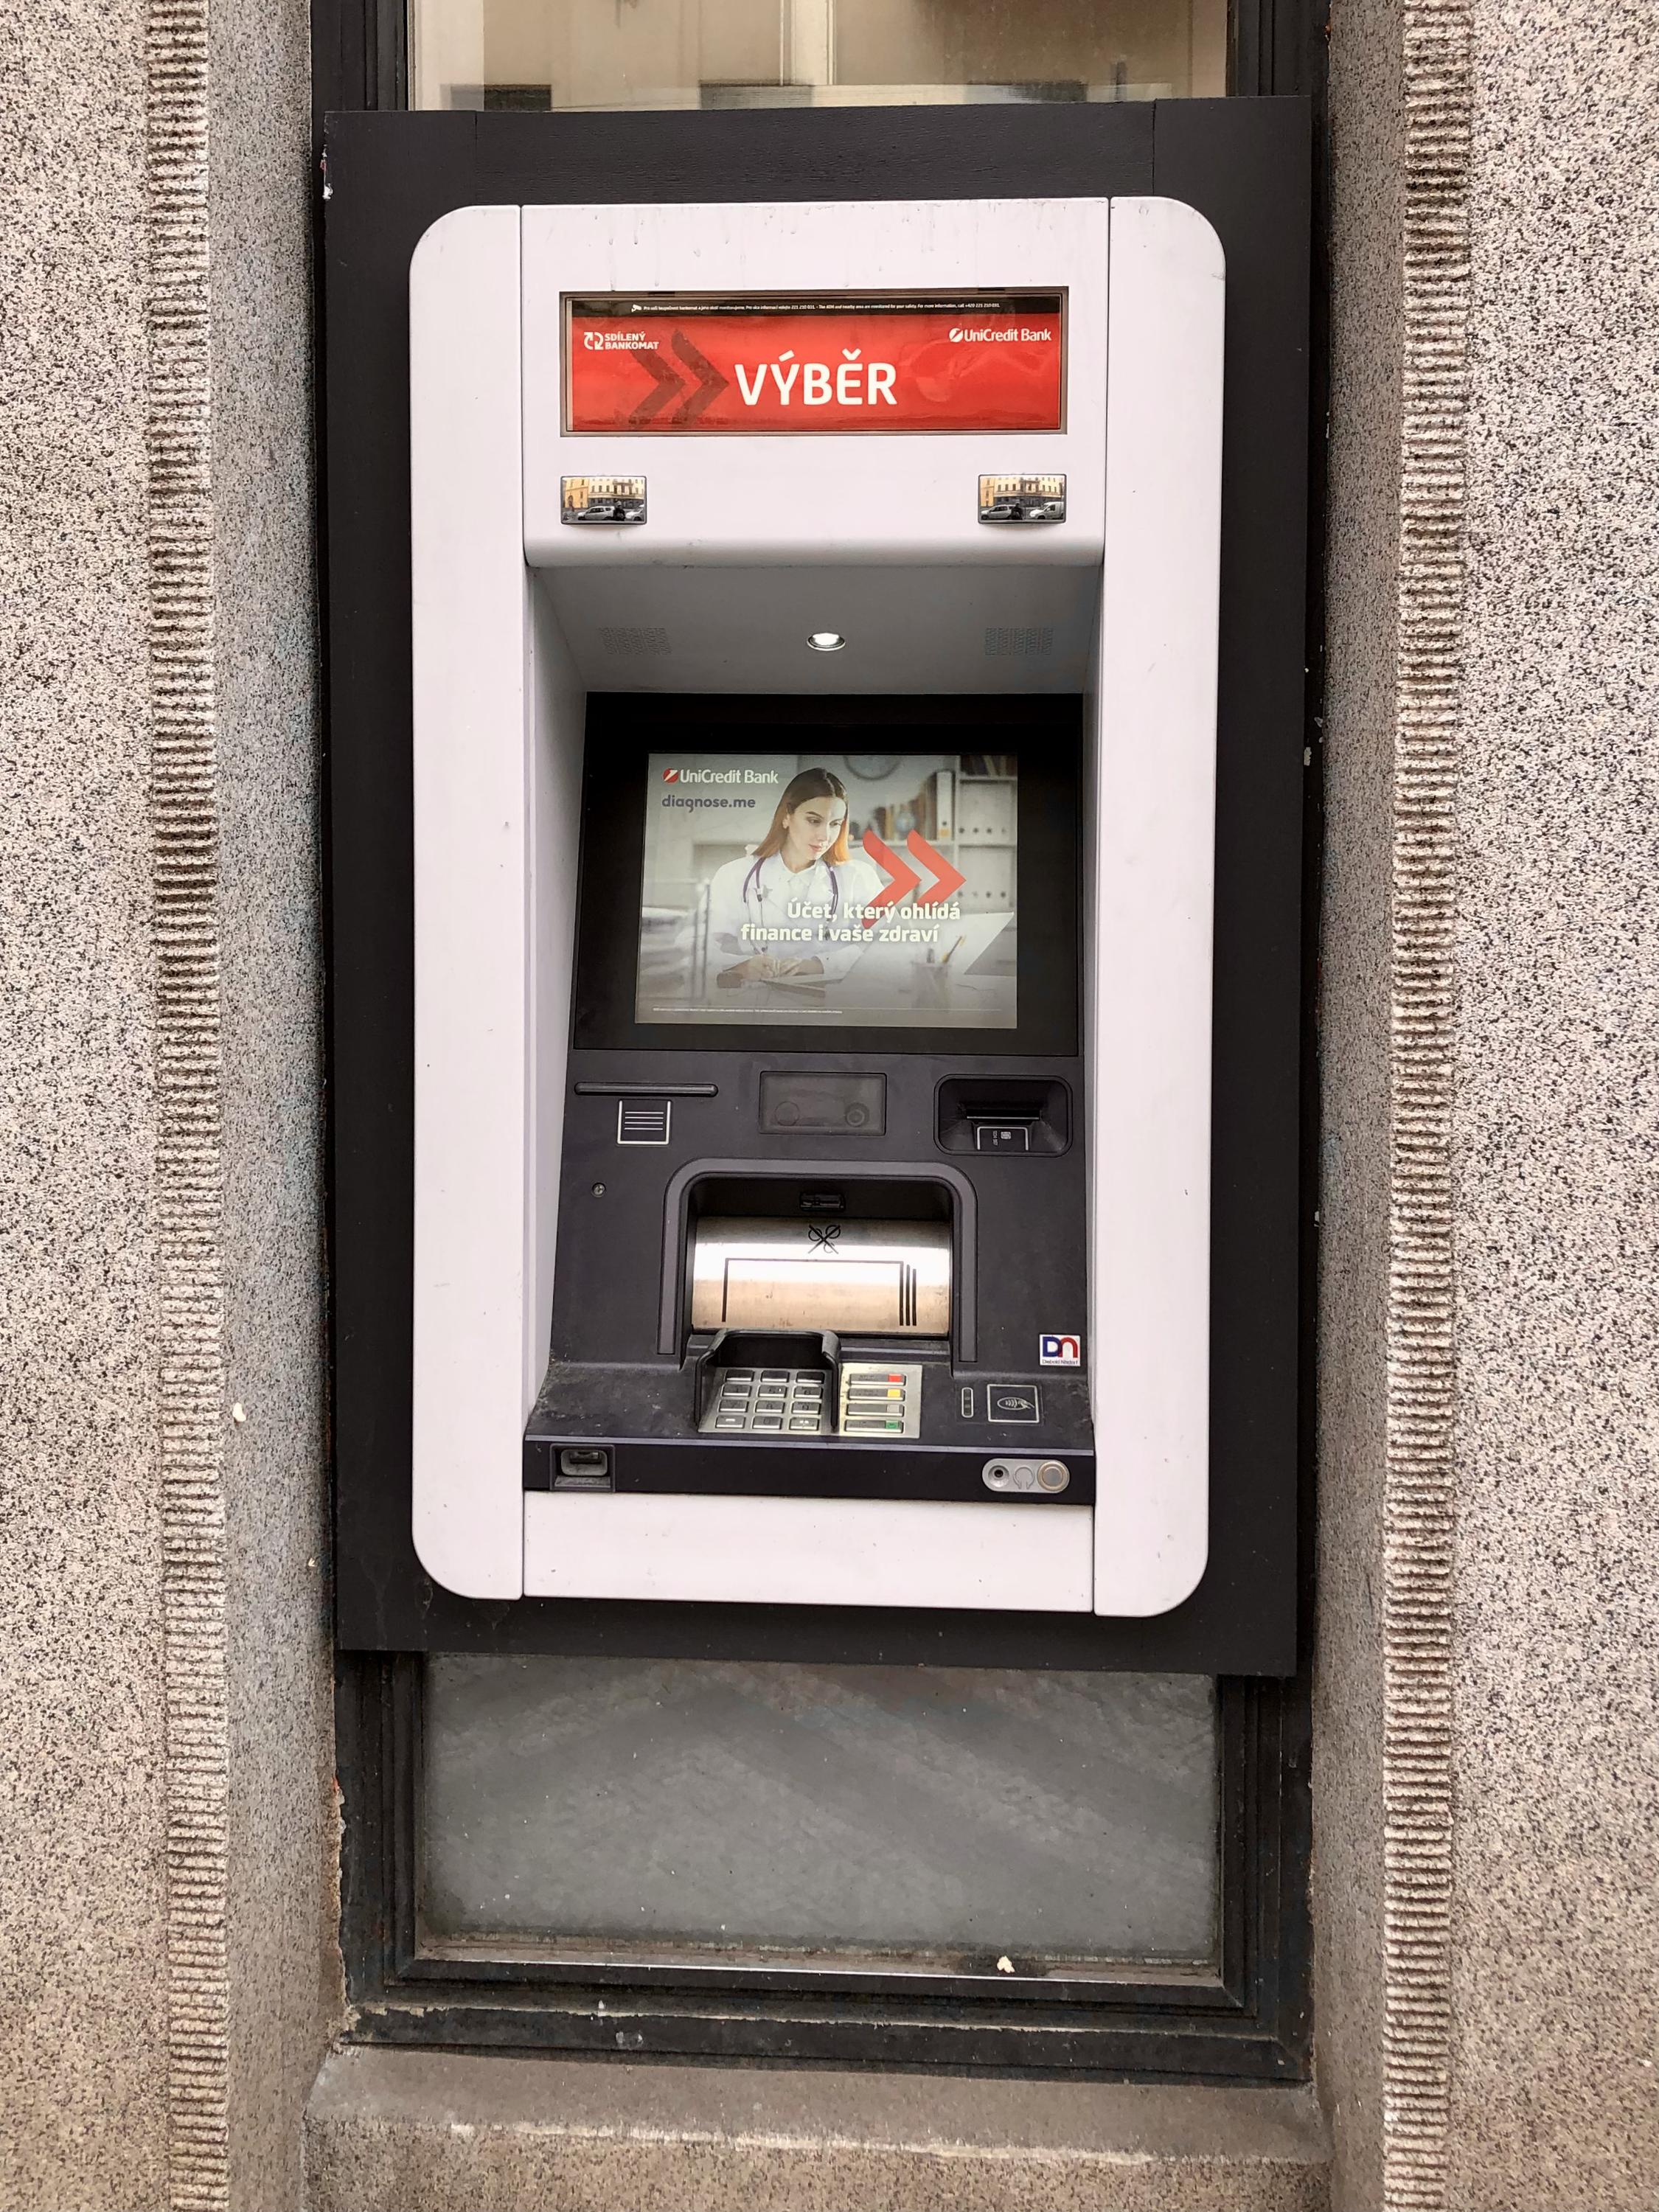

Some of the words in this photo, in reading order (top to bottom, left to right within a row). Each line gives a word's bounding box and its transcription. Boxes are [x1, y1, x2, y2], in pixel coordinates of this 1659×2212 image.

[605, 331, 646, 341] SDÍLENÝ
[964, 328, 1018, 341] UniCredit
[1020, 328, 1051, 341] Bank
[605, 341, 659, 349] BANKOMAT
[734, 348, 897, 406] VÝBĚR
[680, 769, 741, 784] UniCredit
[744, 769, 779, 784] Bank
[661, 794, 756, 813] diagnose.me
[787, 897, 838, 922] Účet,
[844, 902, 897, 923] který
[900, 901, 961, 921] ohlídá
[740, 924, 812, 942] finance
[818, 924, 824, 942] i
[830, 925, 874, 942] vaše
[879, 923, 940, 943] zdraví
